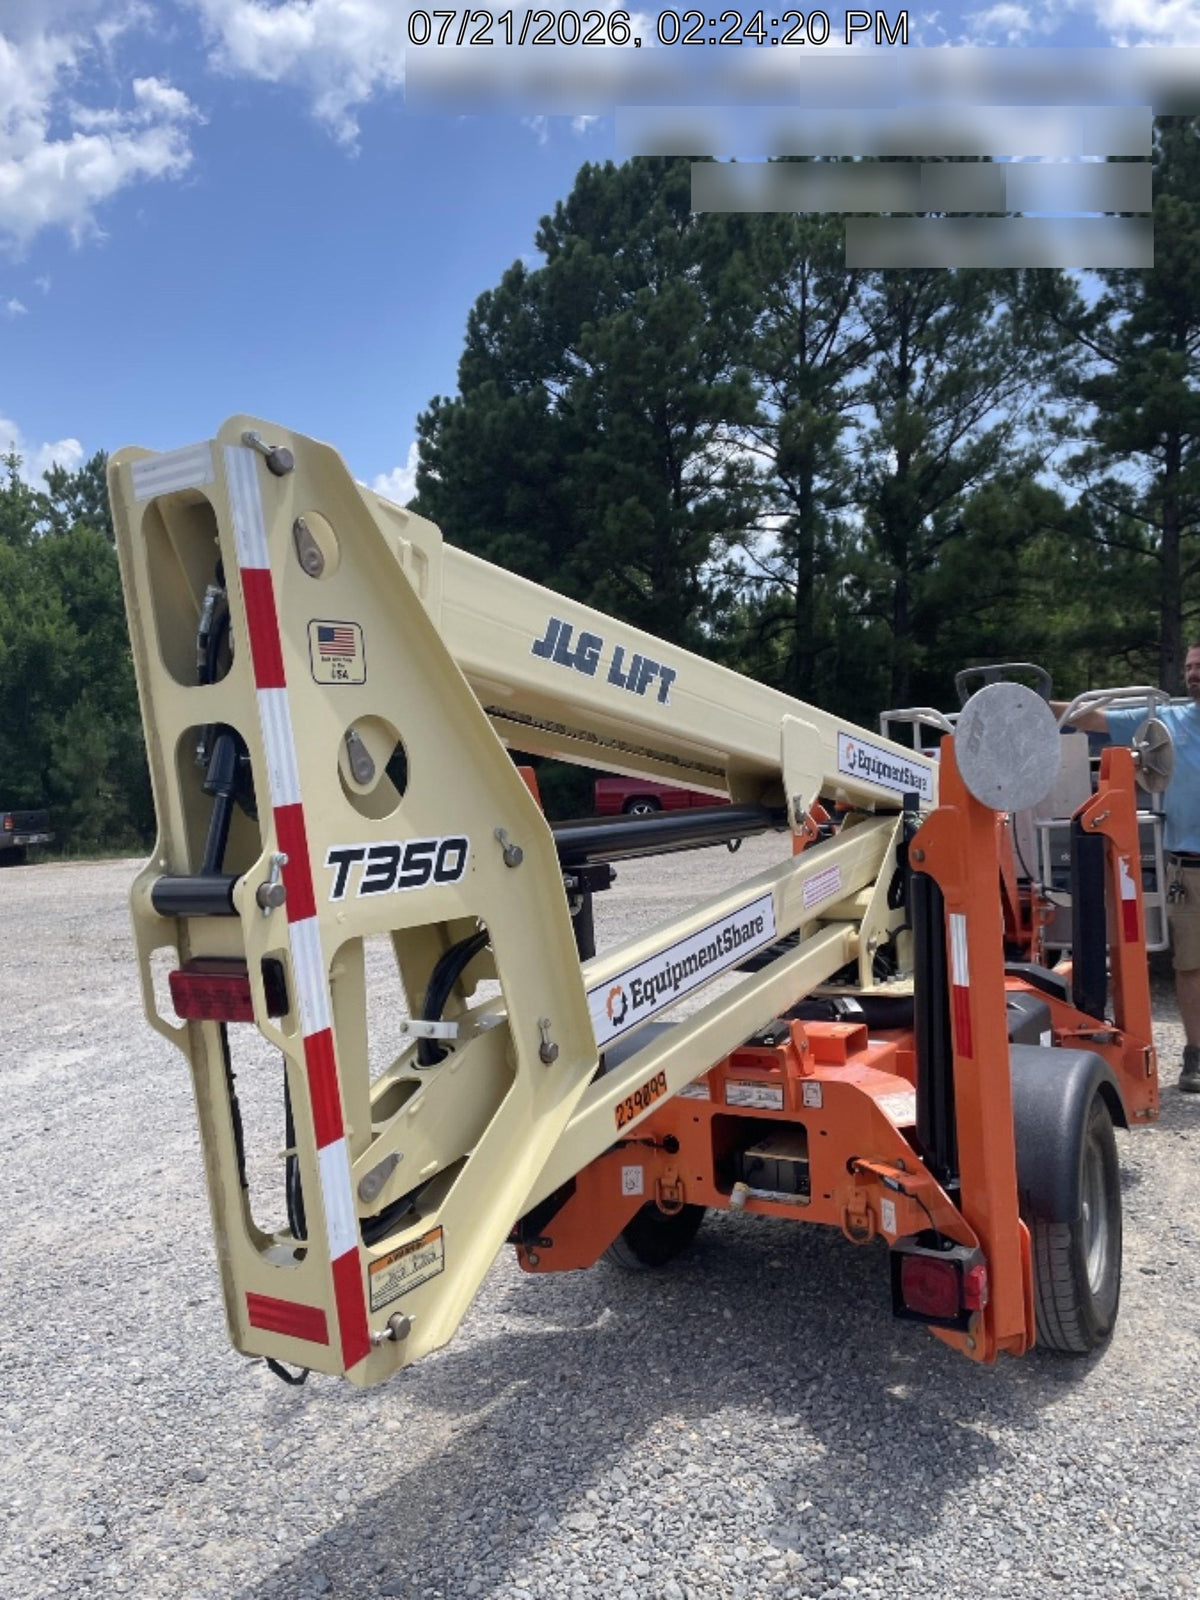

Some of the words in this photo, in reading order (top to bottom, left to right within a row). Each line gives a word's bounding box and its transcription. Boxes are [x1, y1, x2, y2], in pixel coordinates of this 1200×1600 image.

[530, 616, 604, 677] JLG
[607, 645, 677, 704] LIFT
[858, 747, 928, 791] EquipmentShare
[327, 837, 469, 899] T350
[629, 915, 764, 1010] EquipmentShare
